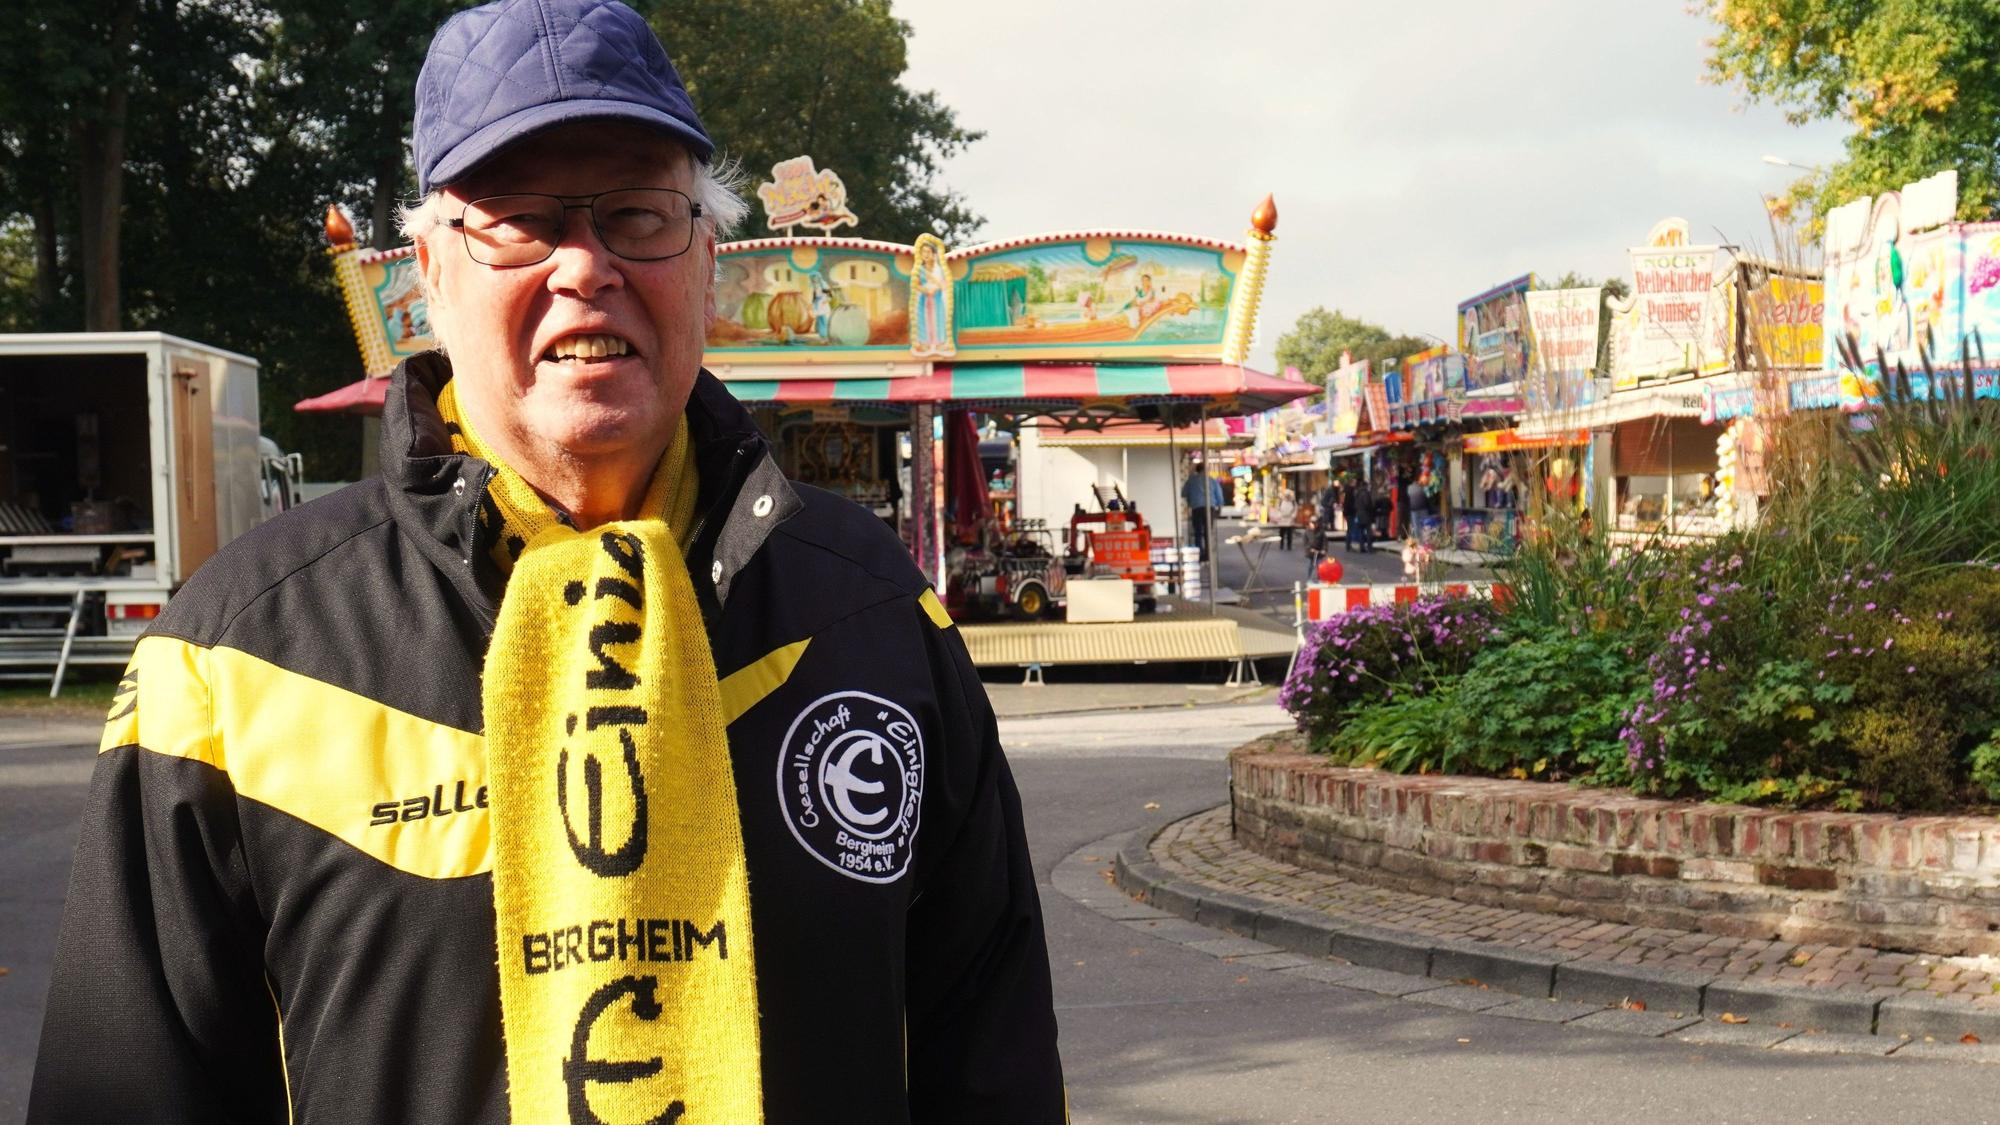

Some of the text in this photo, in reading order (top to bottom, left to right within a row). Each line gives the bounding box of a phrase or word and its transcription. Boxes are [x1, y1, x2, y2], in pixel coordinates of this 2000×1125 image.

[1647, 298, 1701, 324] Pommes
[793, 703, 851, 828] Gesellschaft
[835, 830, 896, 857] Bergheim
[837, 851, 895, 873] 1954 e.V.
[522, 917, 728, 976] BERGHEIM
